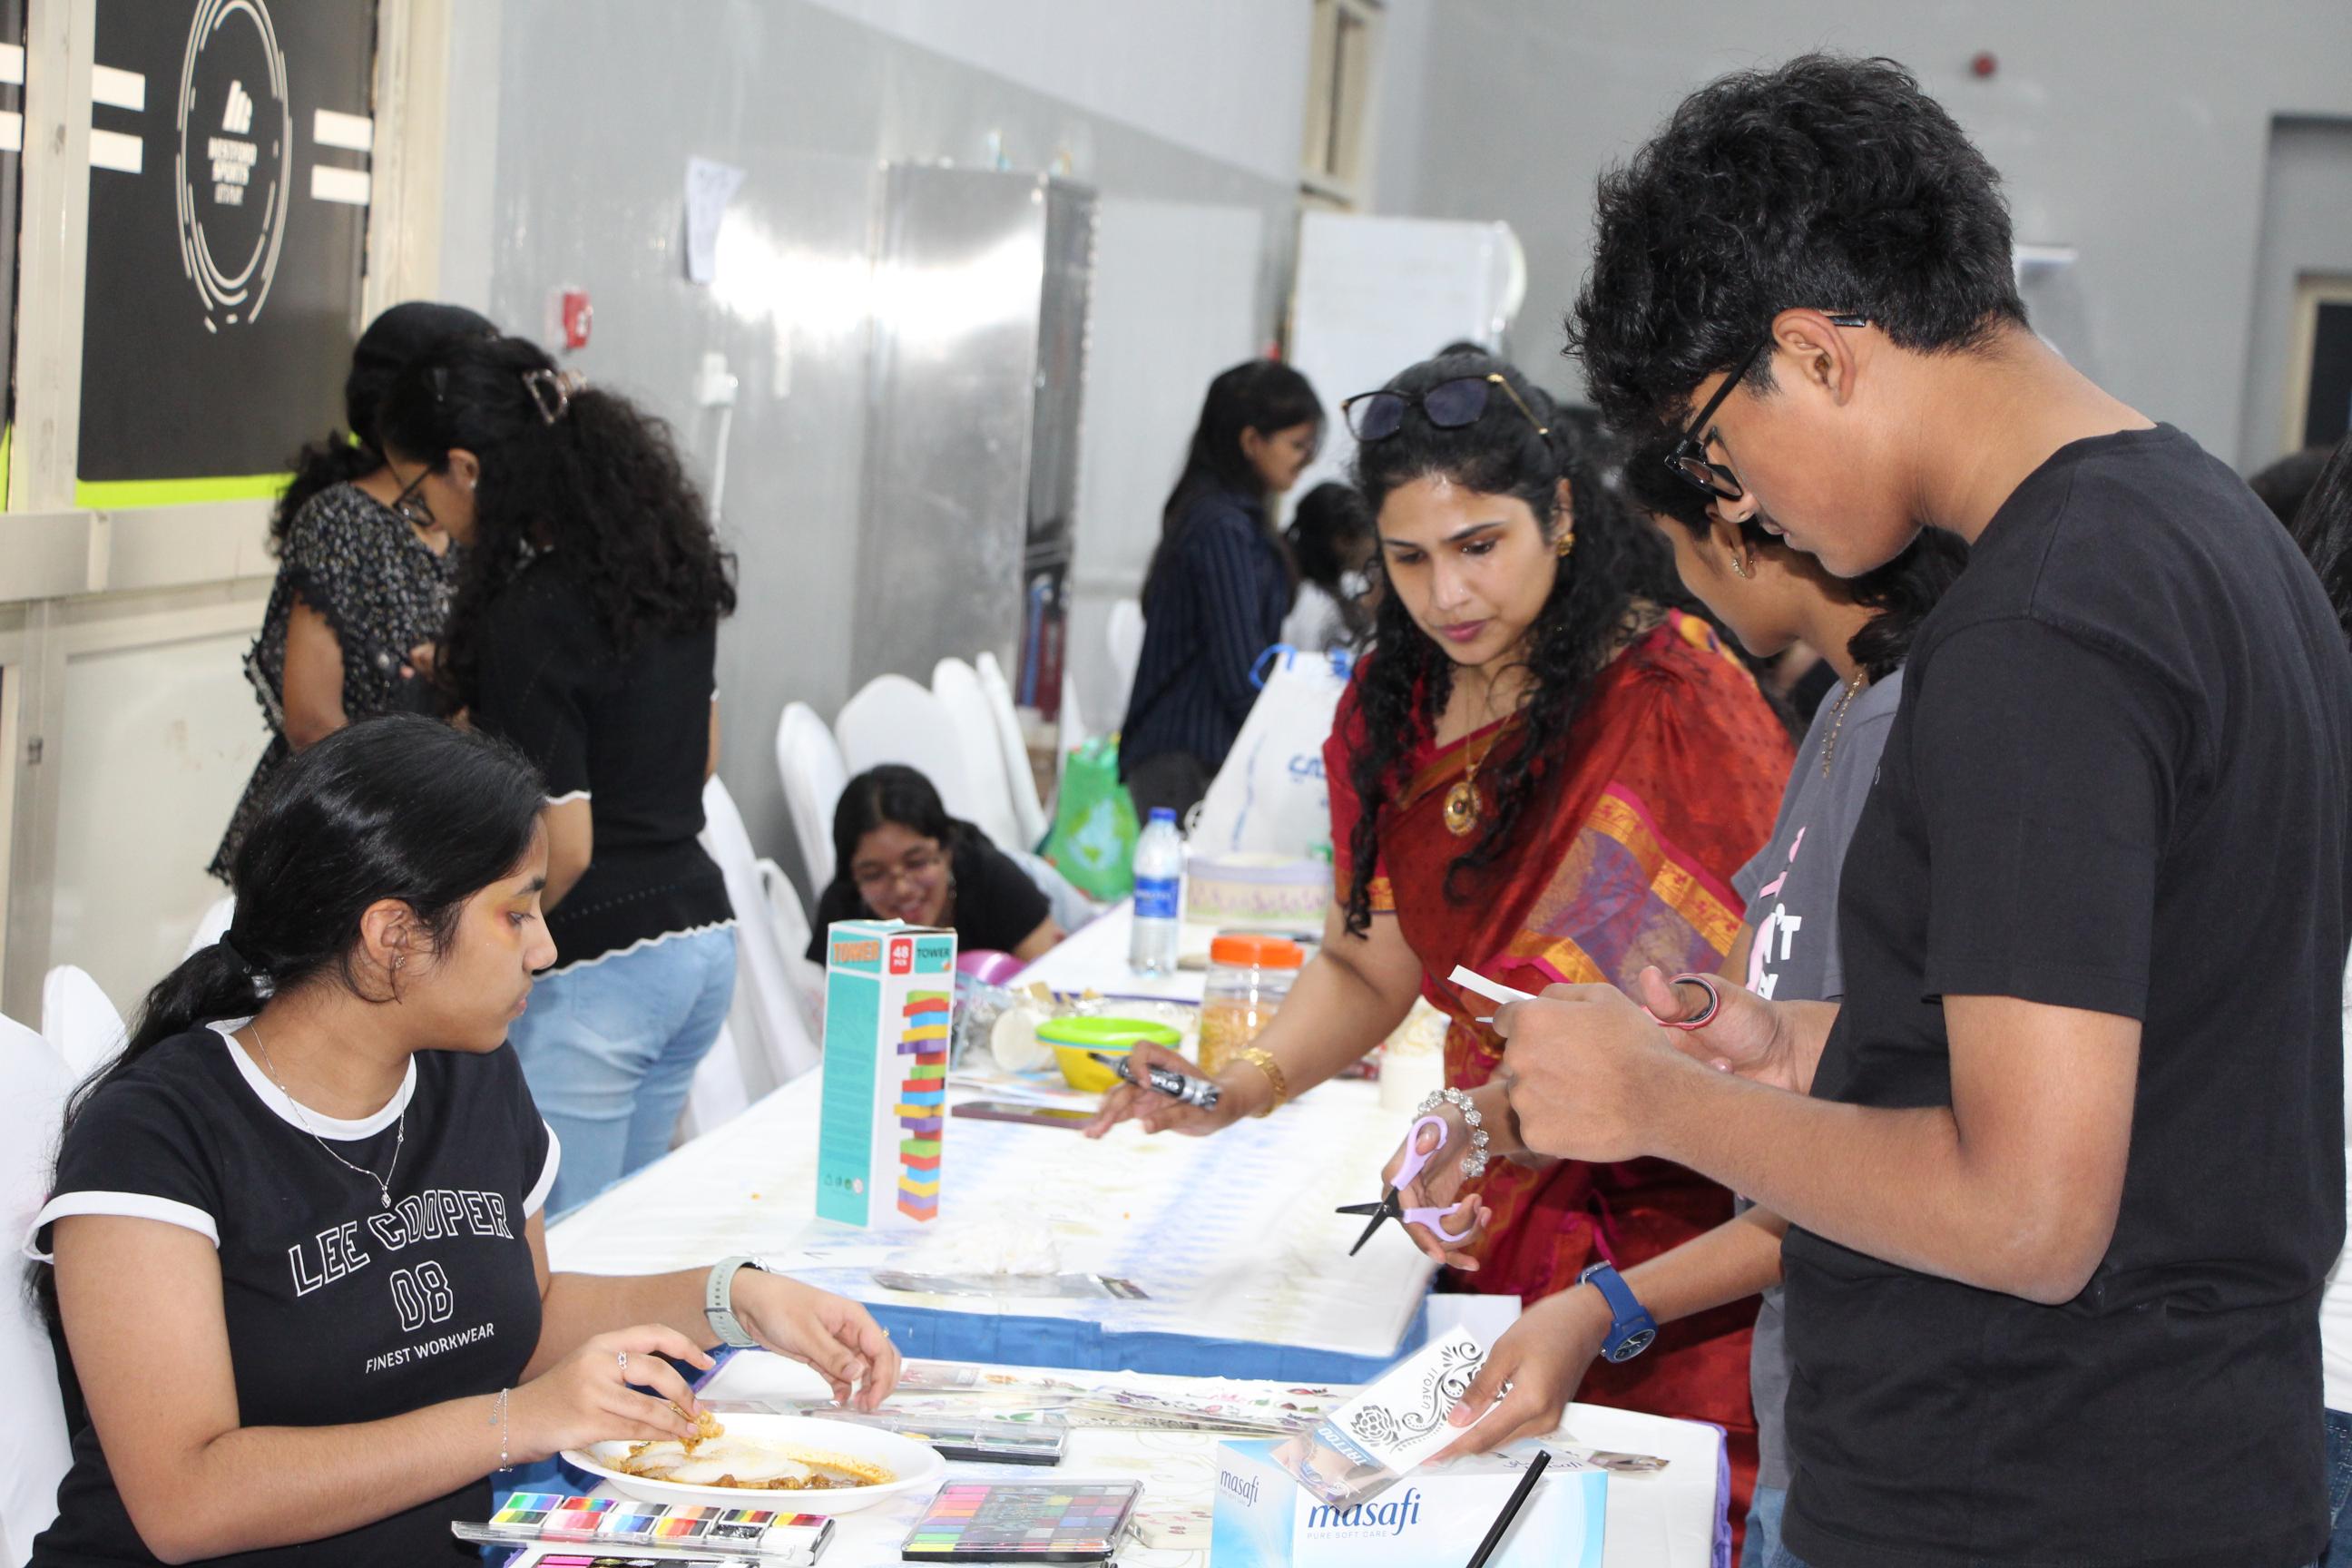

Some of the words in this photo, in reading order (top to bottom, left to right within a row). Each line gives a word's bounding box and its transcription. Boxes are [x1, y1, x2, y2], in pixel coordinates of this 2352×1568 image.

[833, 940, 880, 964] TOWER
[893, 945, 910, 959] 48
[916, 947, 951, 959] TOWER
[288, 1220, 371, 1298] LEE
[368, 1189, 514, 1251] COOPER
[389, 1259, 454, 1332] 08
[365, 1347, 411, 1375] FINEST
[413, 1322, 495, 1359] WORKWEAR
[1318, 1426, 1368, 1467] TATTOO
[1220, 1469, 1259, 1508] masafi
[1307, 1486, 1422, 1536] masafi
[1307, 1532, 1332, 1540] PURE
[1335, 1531, 1359, 1539] SOFT
[1362, 1530, 1388, 1538] CARE
